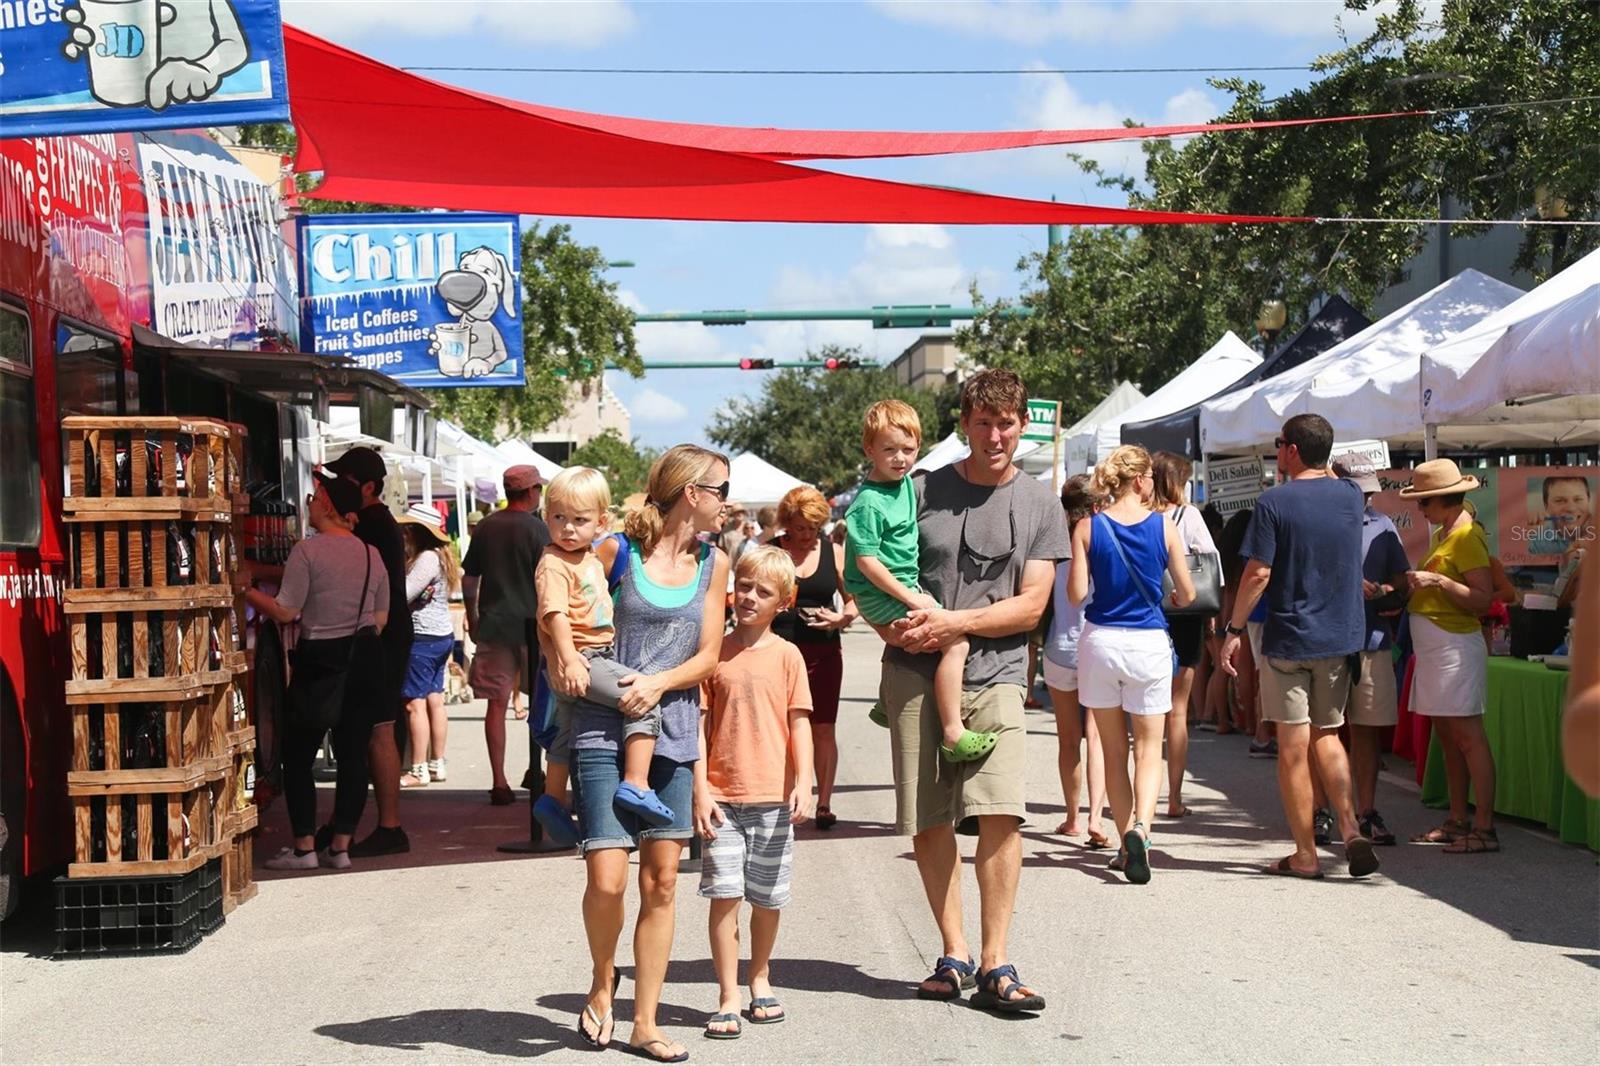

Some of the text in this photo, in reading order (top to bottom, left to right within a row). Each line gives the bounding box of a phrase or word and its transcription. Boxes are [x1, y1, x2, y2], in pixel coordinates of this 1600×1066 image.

[96, 22, 145, 58] JD
[314, 232, 457, 282] Chill
[164, 299, 201, 338] CRAFT
[203, 293, 248, 332] ROASTE
[326, 308, 418, 332] Iced Coffees
[315, 326, 430, 352] Fruit Smoothies
[1209, 464, 1259, 481] Deli Salads
